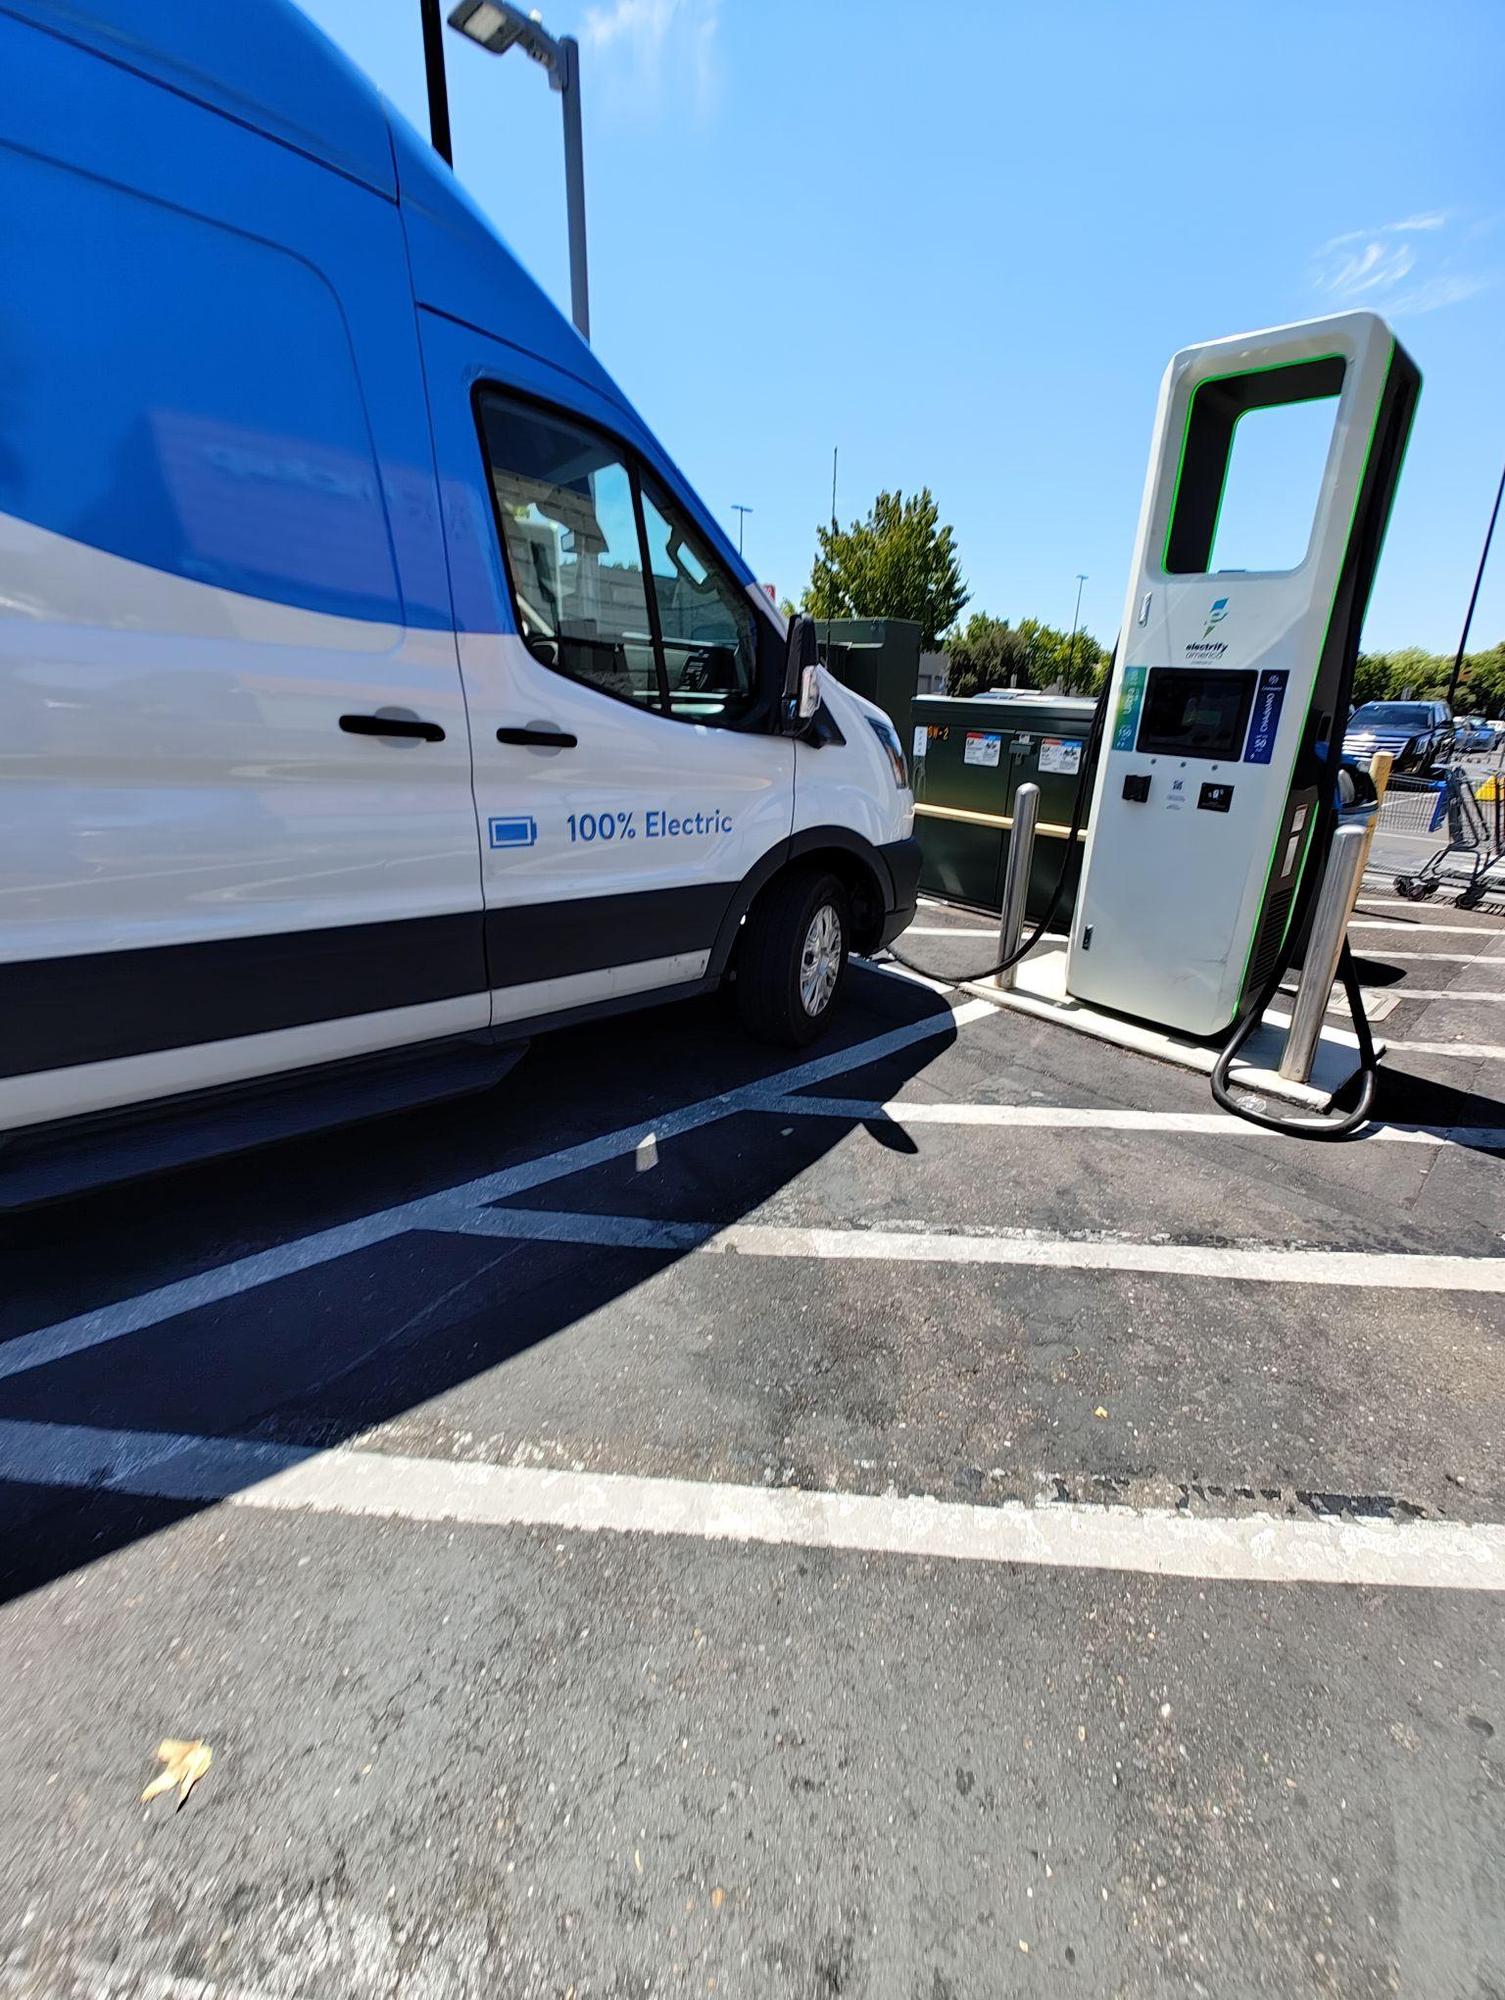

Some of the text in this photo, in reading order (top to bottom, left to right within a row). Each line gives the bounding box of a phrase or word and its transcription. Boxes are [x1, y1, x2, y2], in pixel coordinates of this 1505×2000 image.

[1185, 642, 1229, 653] electrify
[567, 809, 733, 842] 100% Electric
